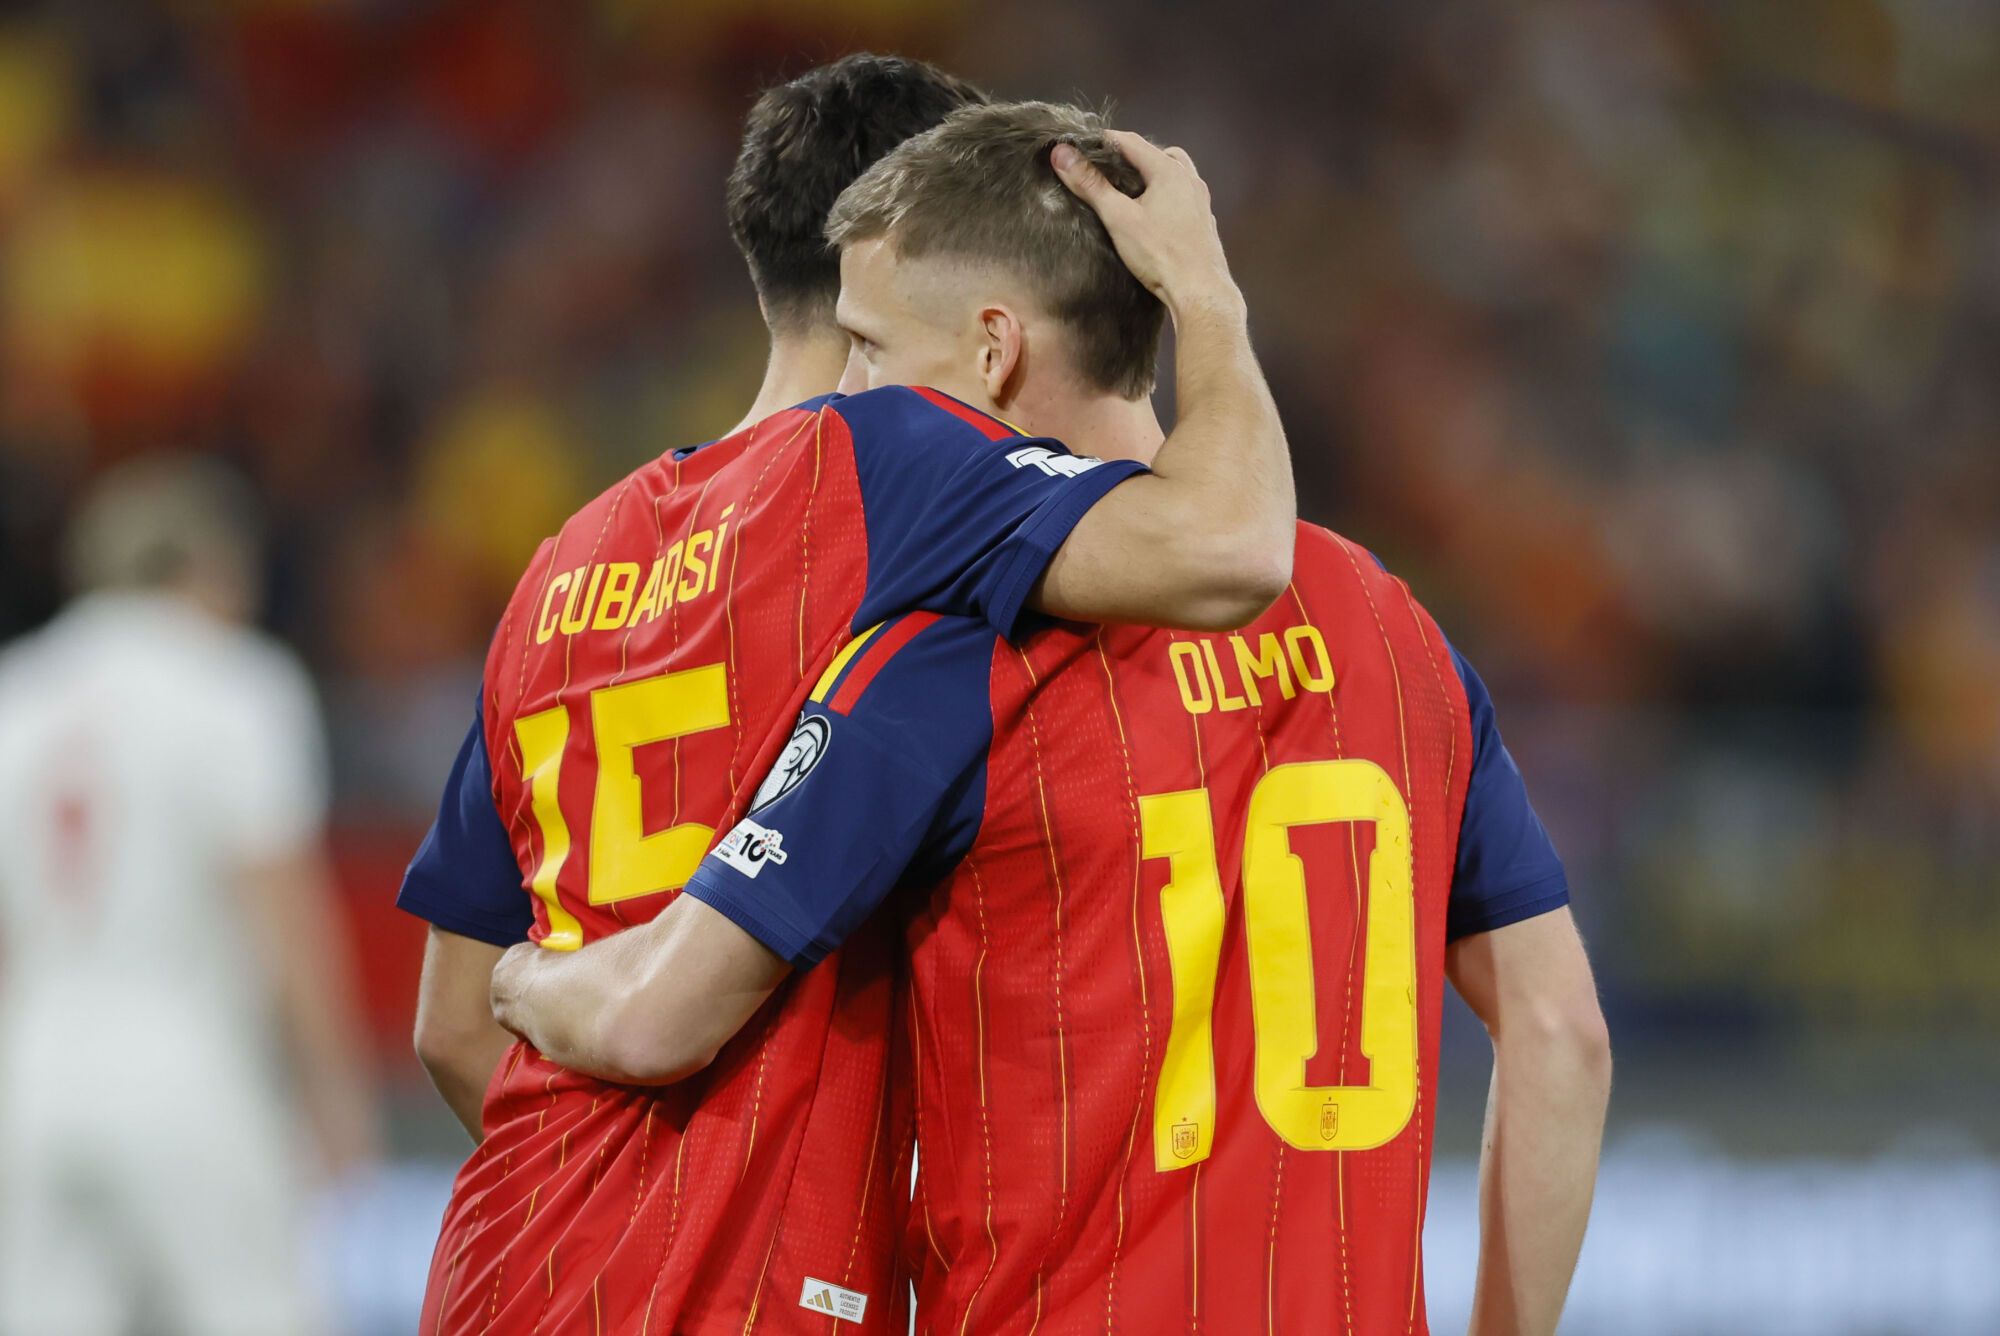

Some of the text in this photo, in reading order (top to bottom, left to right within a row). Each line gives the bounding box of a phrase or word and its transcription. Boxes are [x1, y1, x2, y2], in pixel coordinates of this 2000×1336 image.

[536, 502, 735, 644] CUBARSÍ
[1169, 624, 1335, 714] OLMO
[739, 832, 767, 862] 10
[767, 848, 783, 861] YEARS
[1137, 757, 1416, 1173] 10
